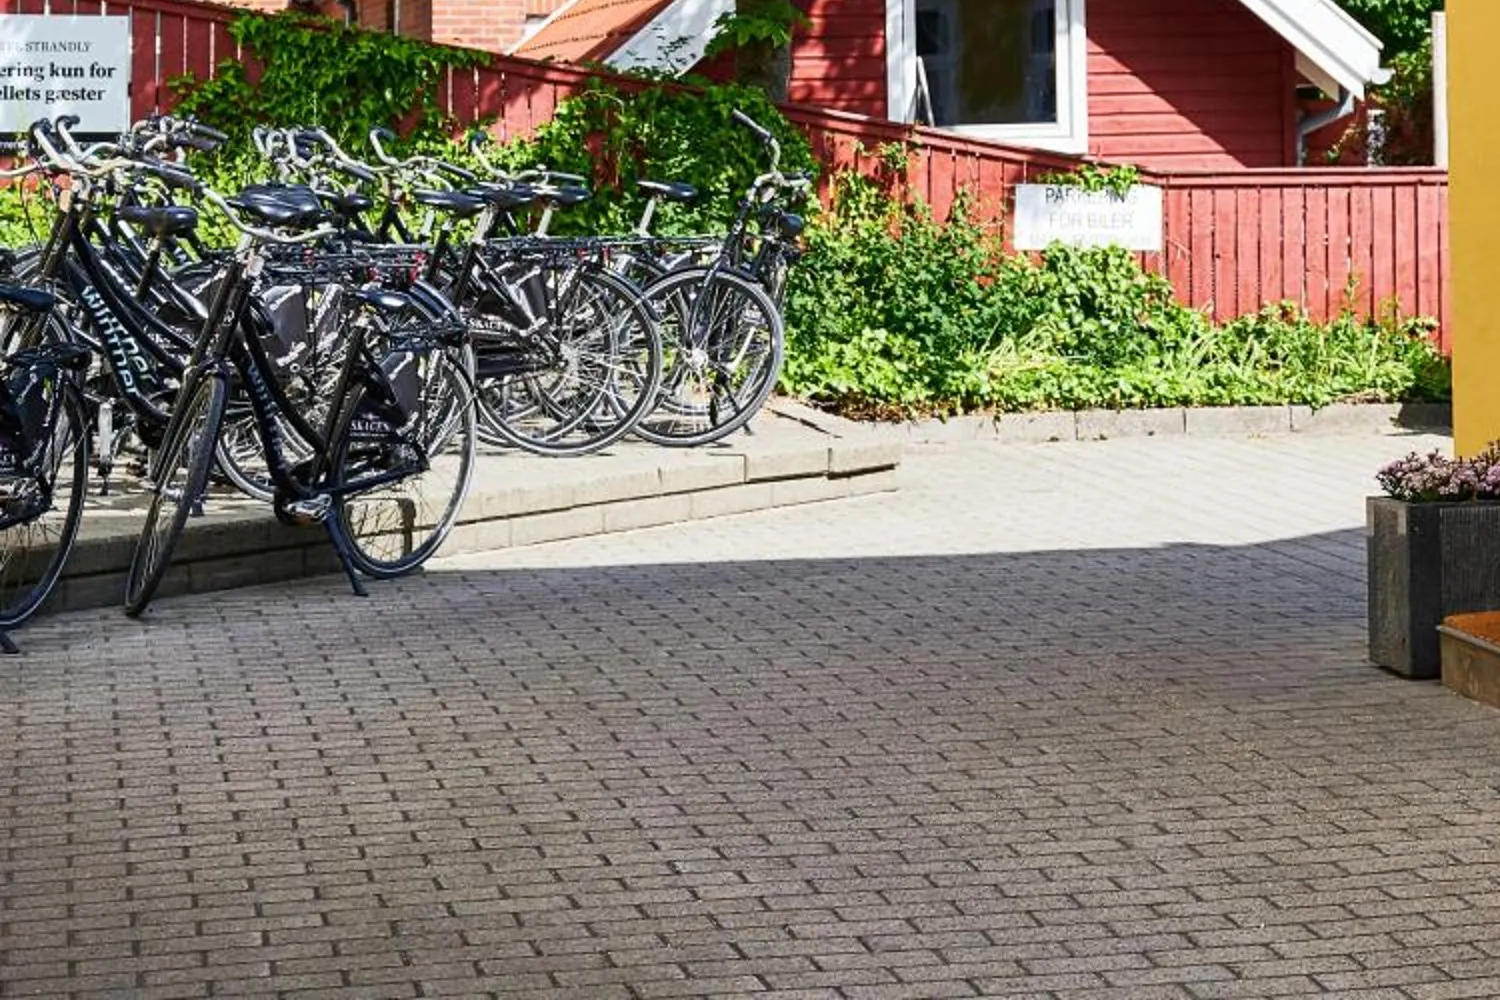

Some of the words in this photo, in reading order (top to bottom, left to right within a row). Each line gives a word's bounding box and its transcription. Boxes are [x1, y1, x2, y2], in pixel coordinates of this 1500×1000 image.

[49, 61, 85, 78] kun
[89, 61, 117, 78] for
[0, 85, 40, 101] llets
[45, 87, 107, 104] gæster
